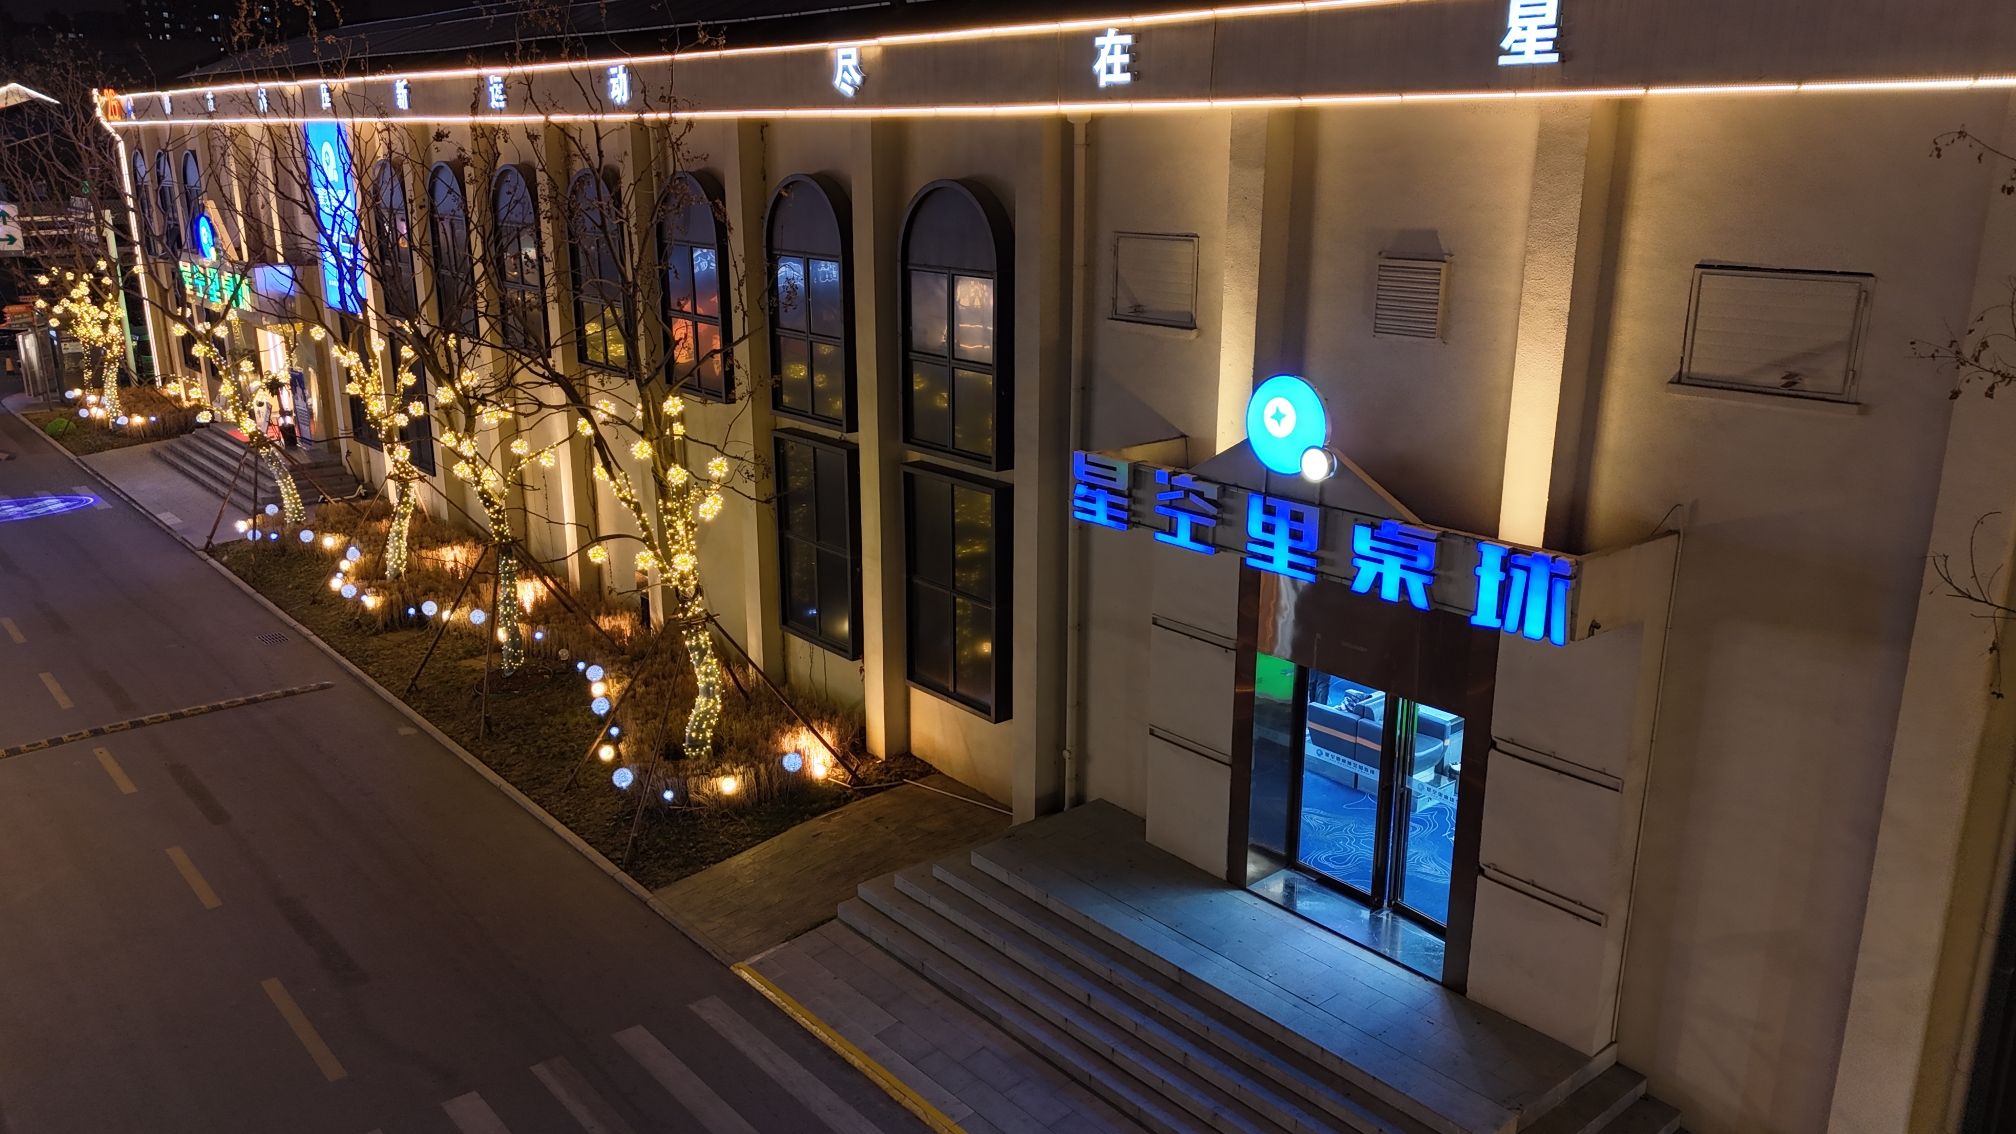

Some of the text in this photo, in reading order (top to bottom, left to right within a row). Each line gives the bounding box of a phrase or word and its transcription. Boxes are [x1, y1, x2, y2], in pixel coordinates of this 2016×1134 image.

[1072, 449, 1572, 648] 星空里桌球
